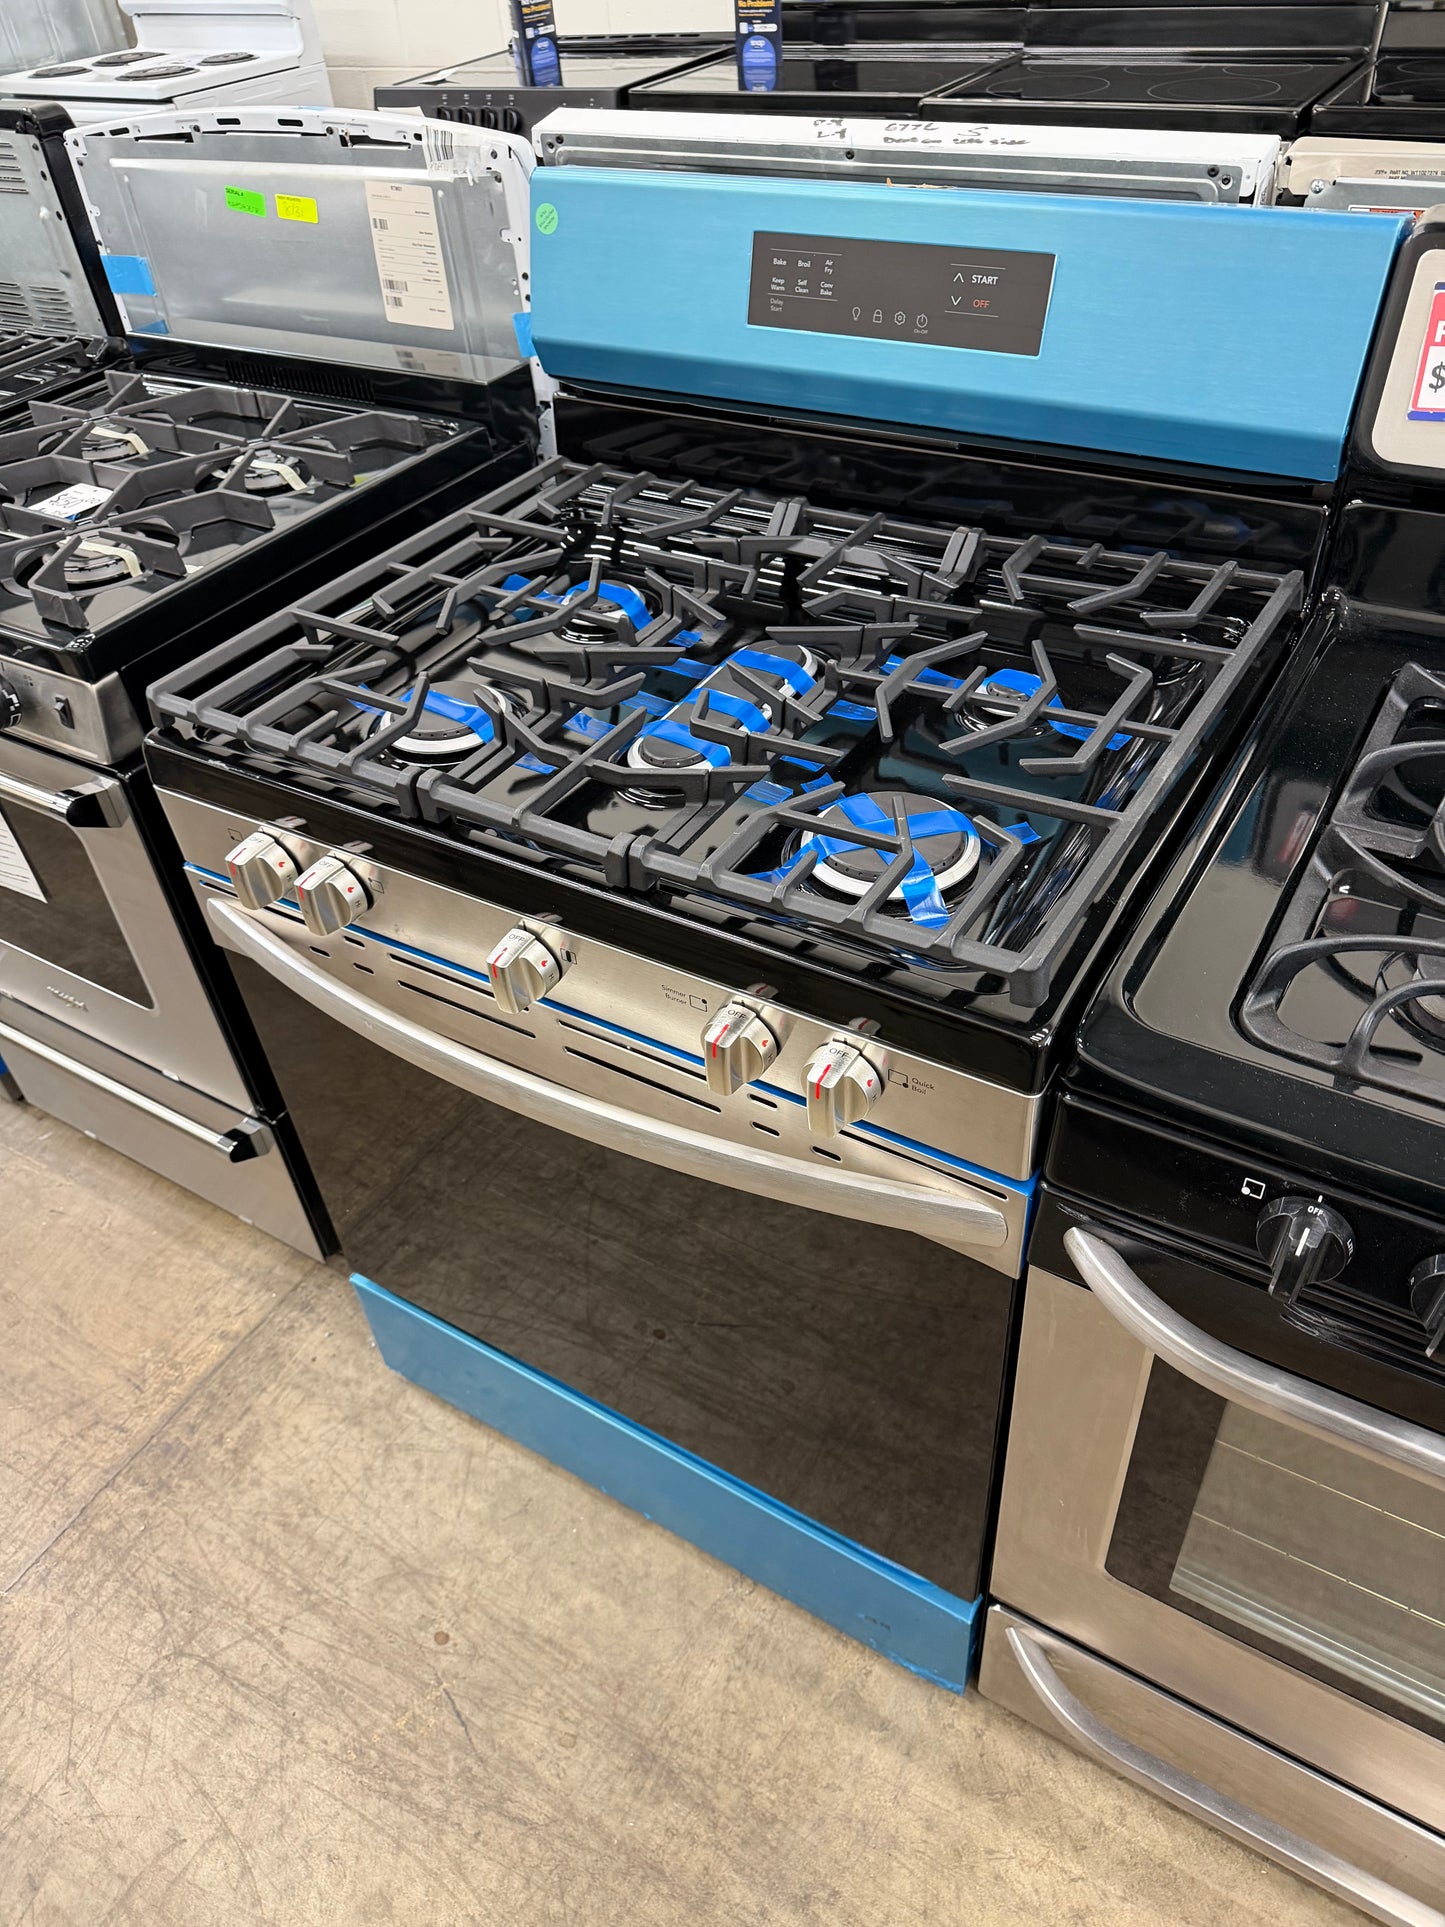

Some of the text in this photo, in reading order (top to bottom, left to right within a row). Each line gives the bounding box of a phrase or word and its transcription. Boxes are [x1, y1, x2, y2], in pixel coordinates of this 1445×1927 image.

[773, 257, 787, 266] Bake
[797, 259, 811, 268] Broil
[824, 266, 833, 275] Fry
[772, 277, 785, 285] Keep
[820, 281, 833, 289] Conv
[971, 274, 998, 286] START
[770, 283, 832, 296] Warm Clean Bake
[770, 298, 784, 306] Delay
[972, 299, 990, 309] OFF
[249, 836, 265, 845] OFF
[318, 860, 335, 869] OFF
[508, 933, 525, 942] OFF
[661, 984, 687, 998] Simmer
[664, 993, 687, 1005] Burner
[727, 1008, 747, 1020] OFF
[829, 1047, 850, 1058] OFF
[911, 1076, 935, 1091] Quick
[911, 1085, 927, 1096] Boil
[1307, 1205, 1324, 1217] OFF
